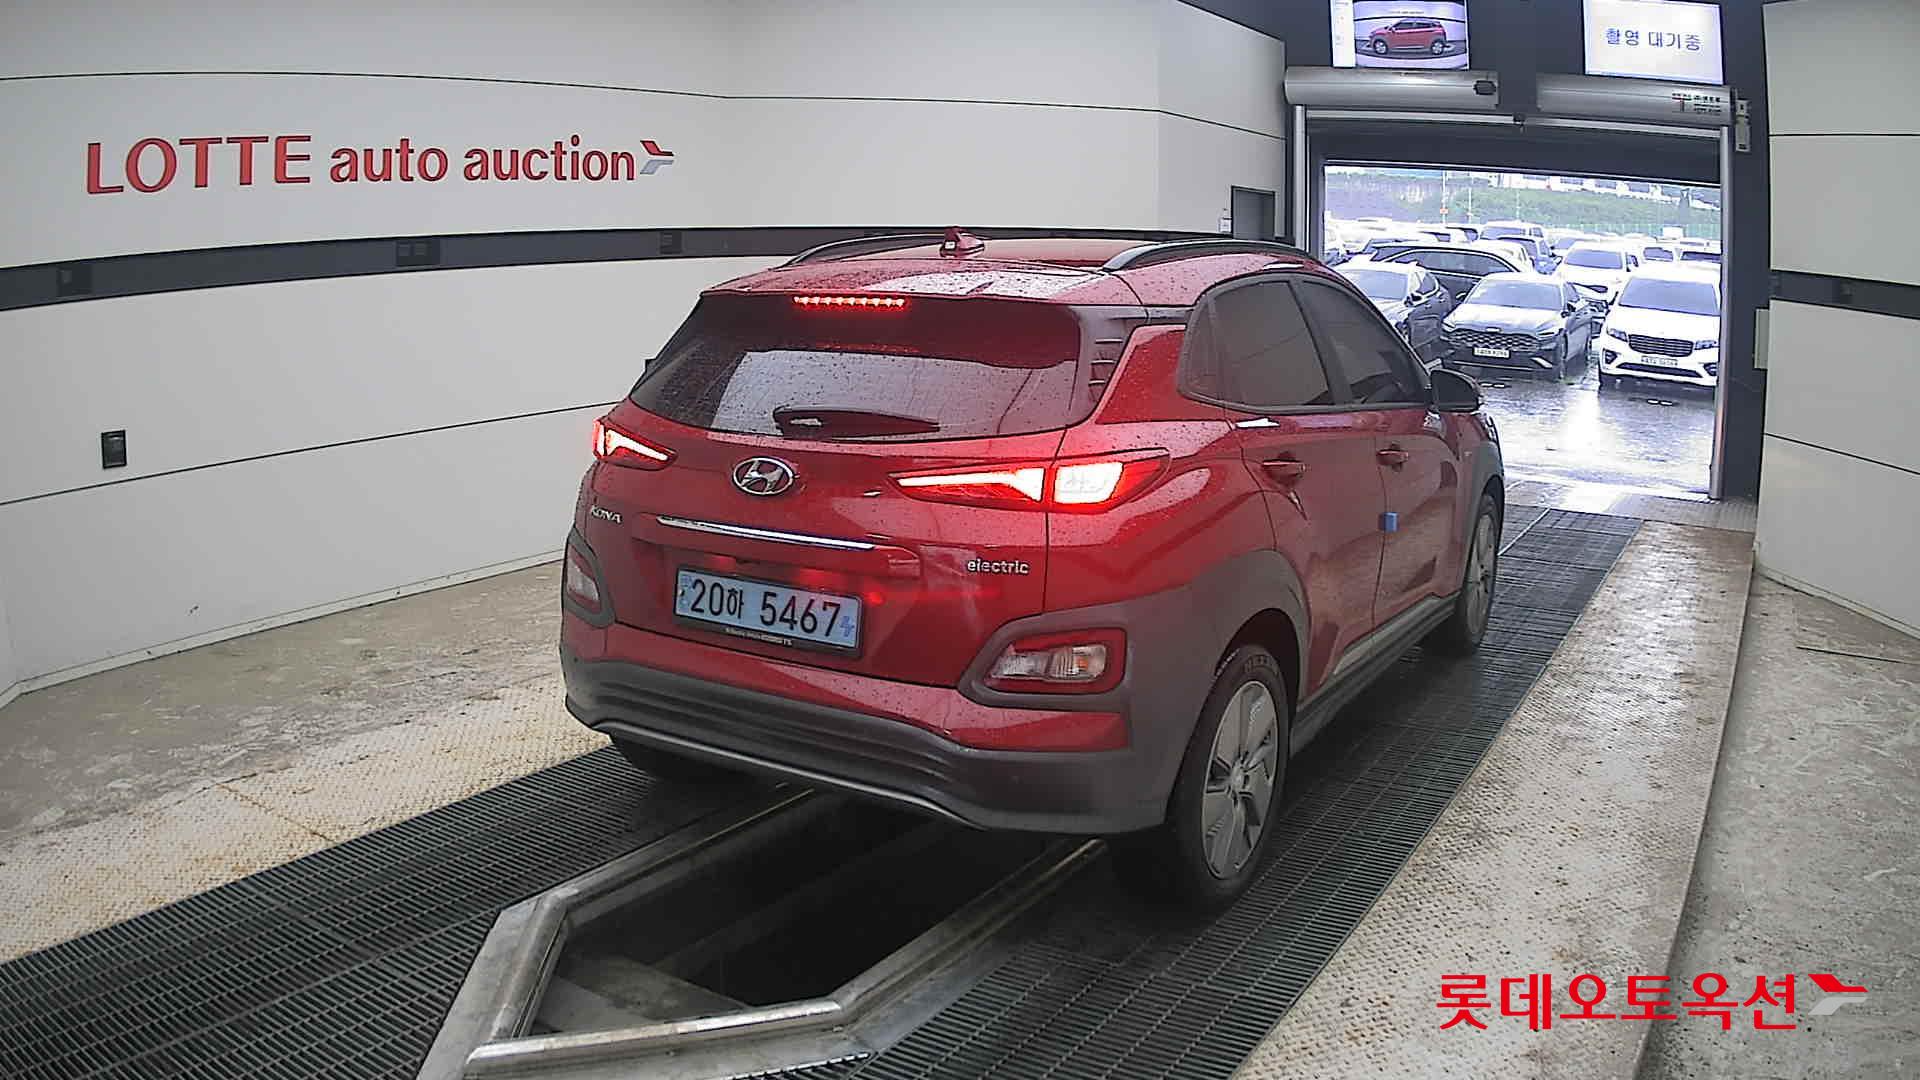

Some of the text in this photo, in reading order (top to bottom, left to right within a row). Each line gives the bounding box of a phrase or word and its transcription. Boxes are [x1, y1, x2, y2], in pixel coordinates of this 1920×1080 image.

[1648, 31, 1701, 51] 대기중
[87, 134, 635, 195] LOTTE auto auction
[967, 558, 1028, 574] electric
[690, 579, 744, 620] 20하
[760, 591, 841, 638] 5467
